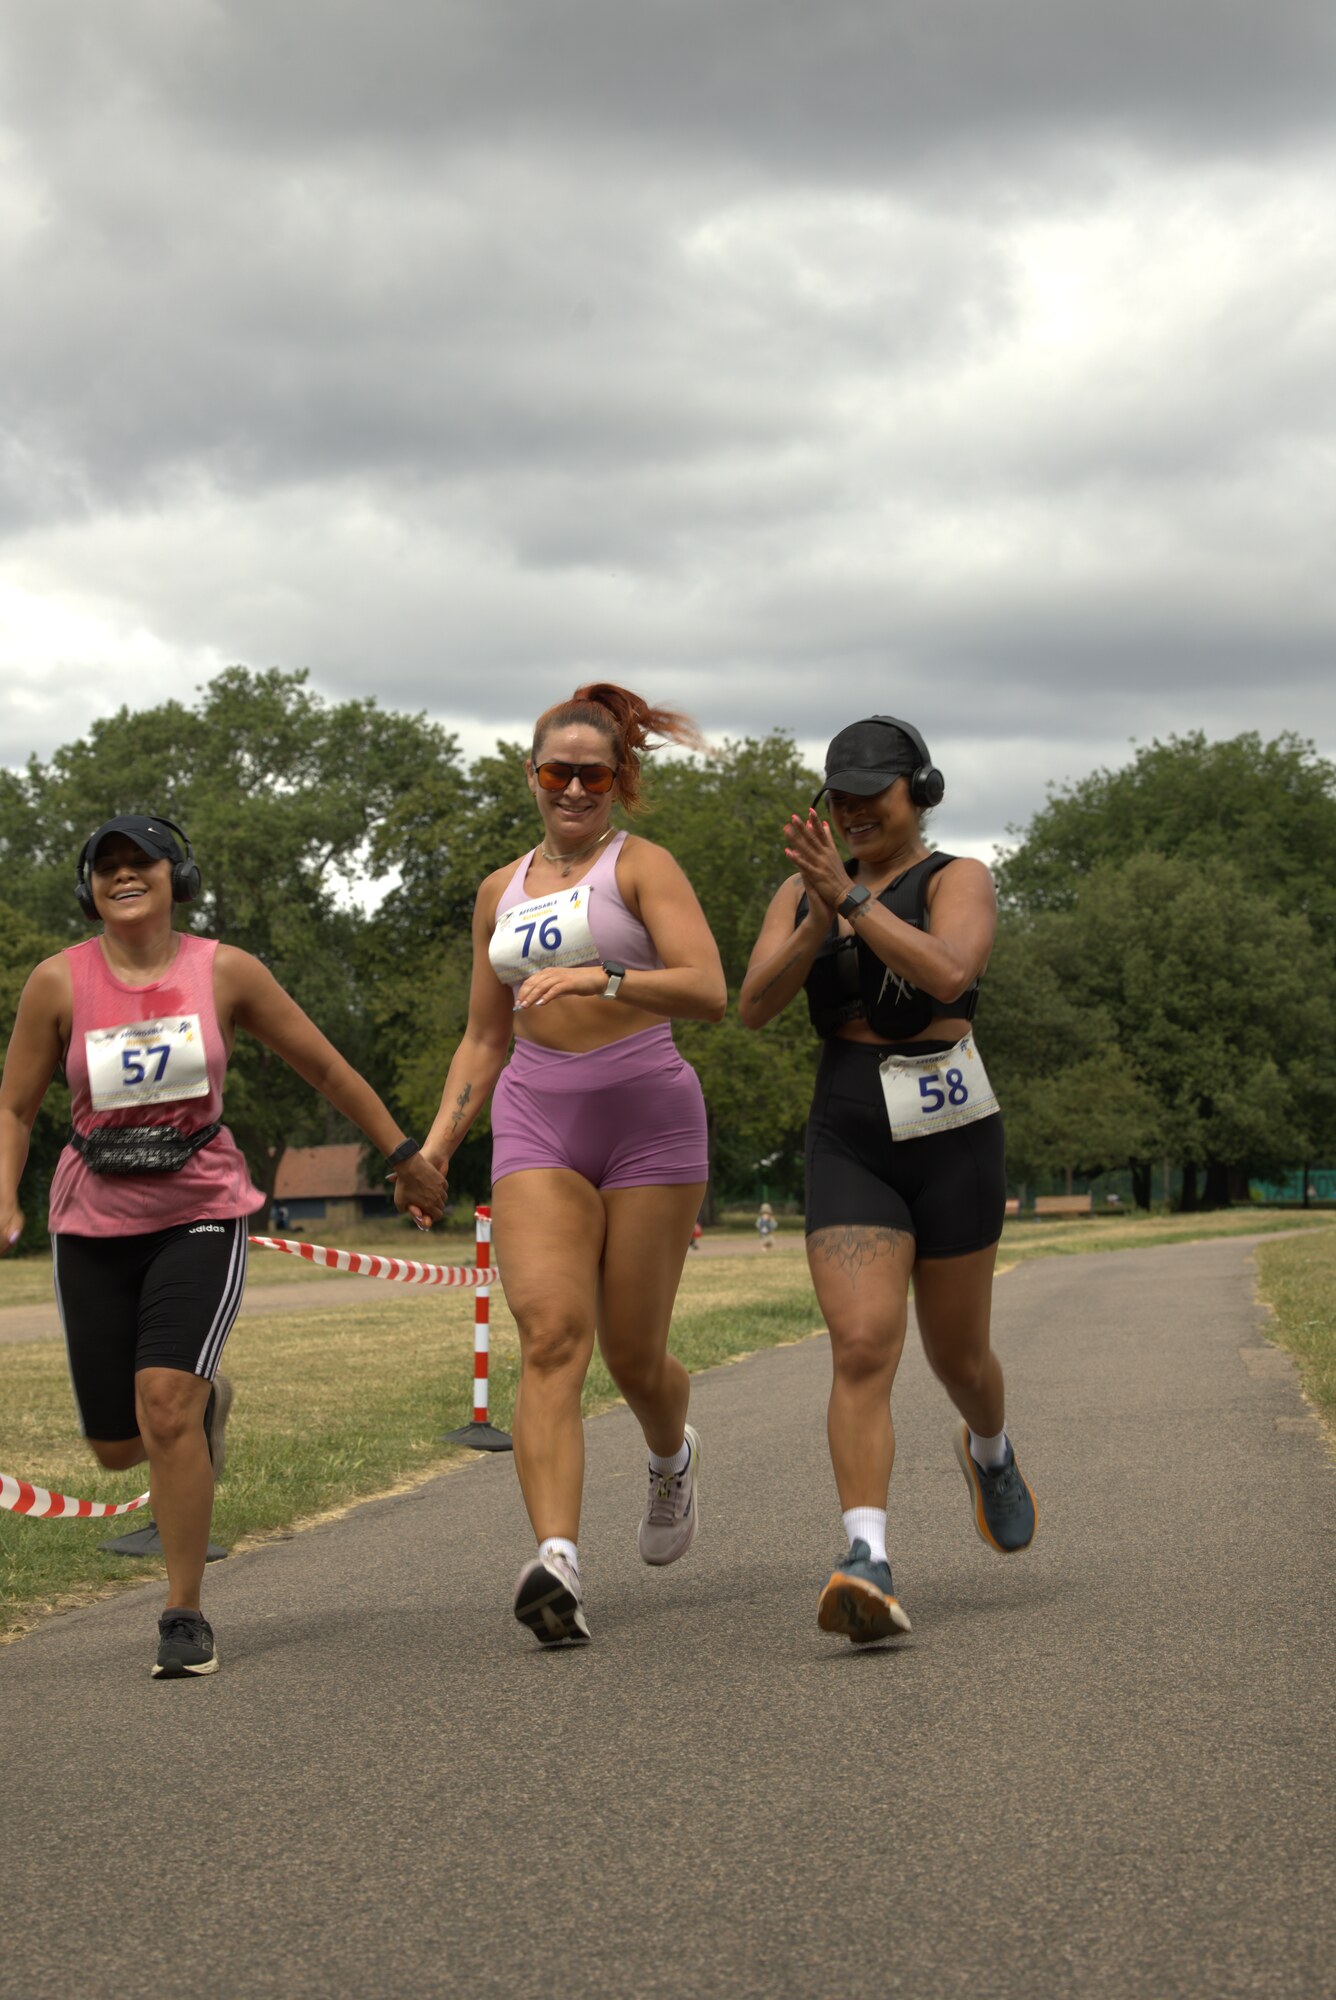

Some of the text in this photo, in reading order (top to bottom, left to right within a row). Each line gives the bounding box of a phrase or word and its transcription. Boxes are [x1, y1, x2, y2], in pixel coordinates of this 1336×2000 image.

[518, 899, 558, 916] AFFORDABLE
[569, 889, 579, 902] A
[514, 914, 562, 959] 76
[122, 1044, 171, 1086] 57
[918, 1068, 969, 1114] 58
